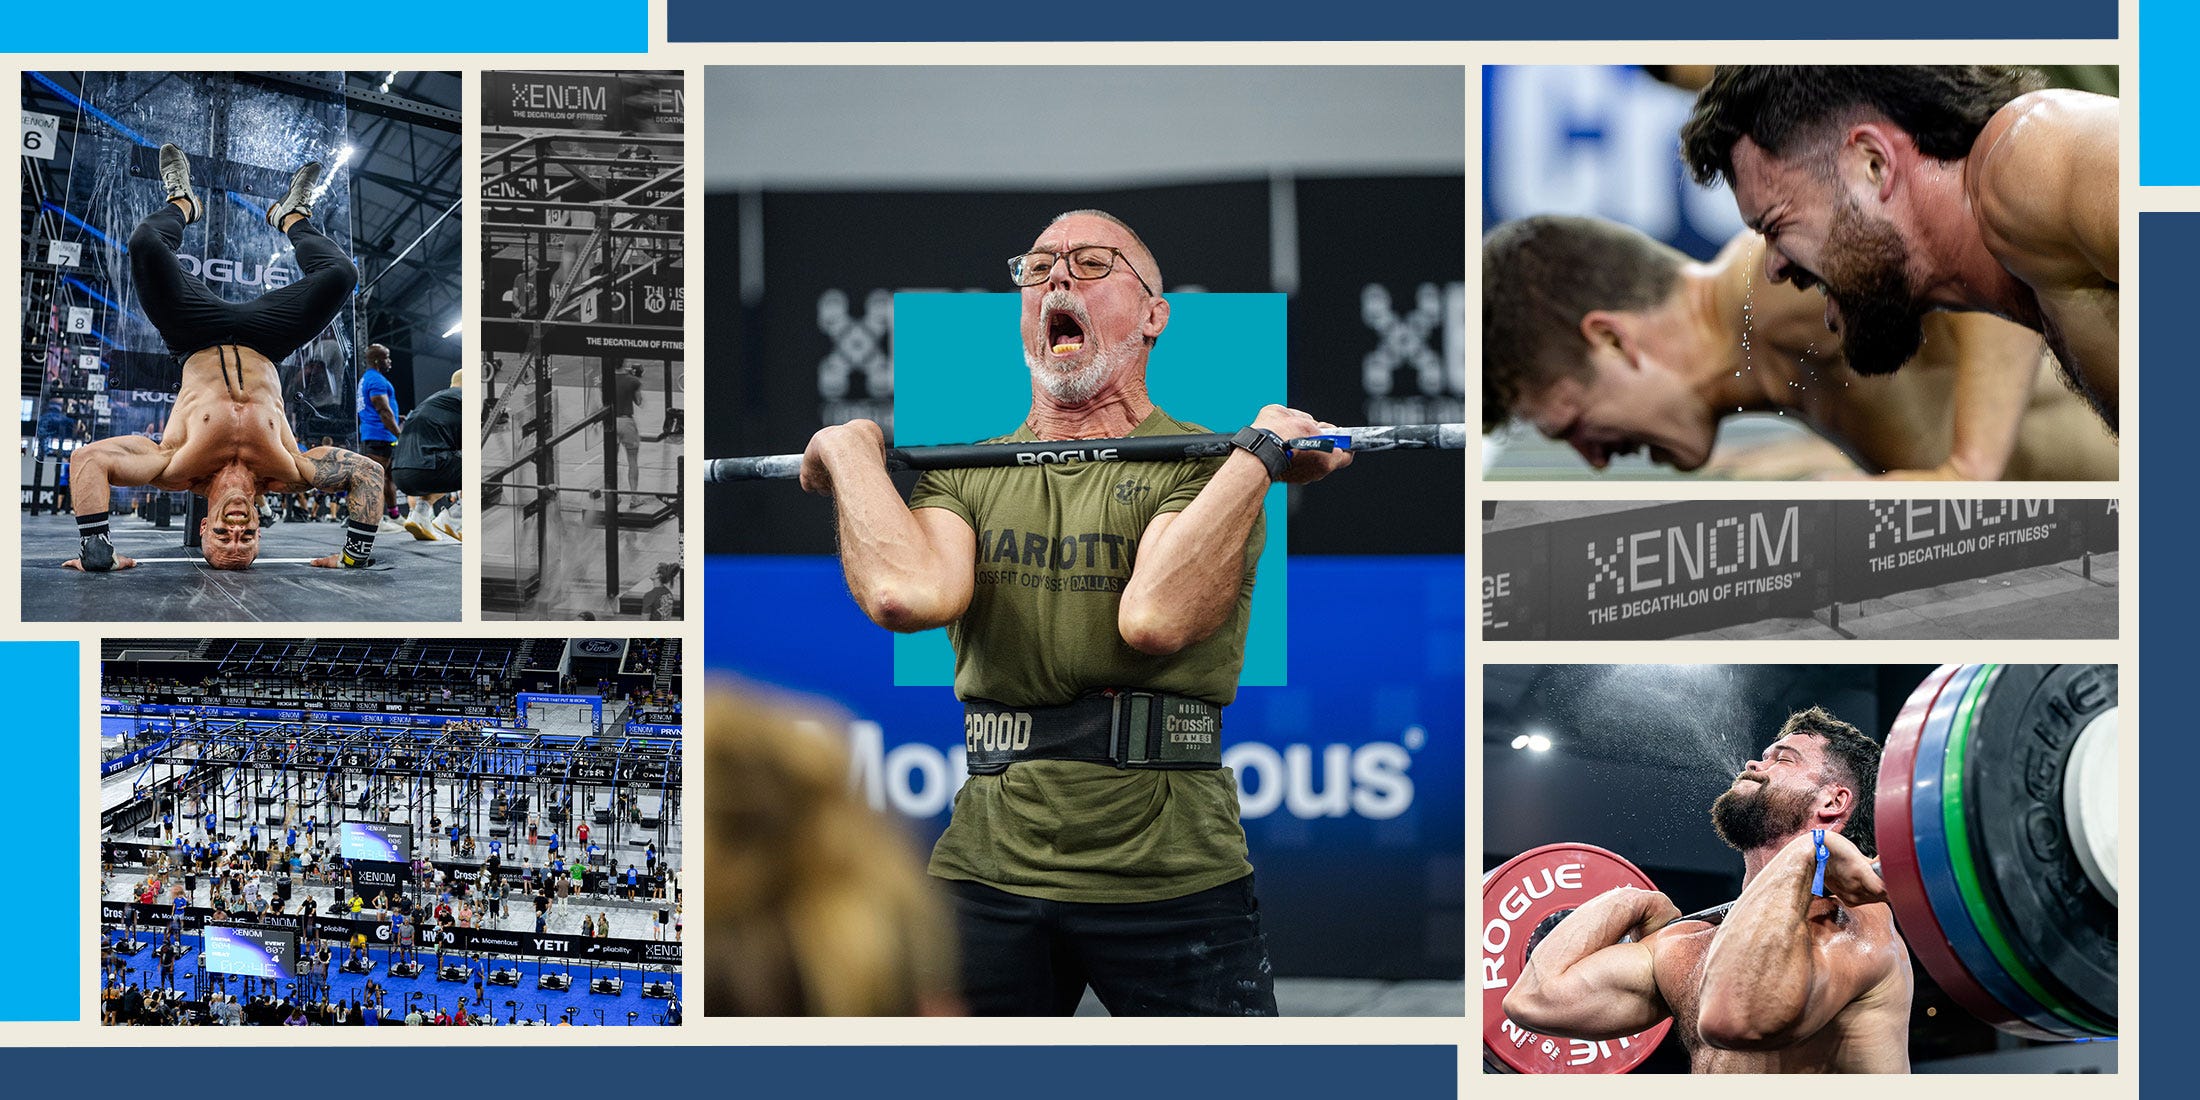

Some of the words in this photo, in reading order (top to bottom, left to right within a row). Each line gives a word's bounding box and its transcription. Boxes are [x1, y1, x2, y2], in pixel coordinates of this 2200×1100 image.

[511, 83, 607, 111] XENOM
[512, 110, 526, 118] THE
[527, 111, 566, 120] DECATHLON
[566, 112, 576, 120] OF
[23, 131, 42, 150] 6
[59, 254, 70, 266] 7
[175, 253, 290, 289] OGUE
[585, 298, 592, 316] 4
[75, 318, 85, 329] 8
[586, 336, 602, 346] THE
[603, 337, 649, 347] DECATHLON
[650, 340, 661, 348] OF
[85, 357, 93, 366] 9
[1016, 449, 1119, 467] ROGUE
[1587, 505, 1799, 601] XENOM
[1868, 554, 1896, 573] THE
[1898, 538, 1976, 568] DECATHLON
[1978, 534, 1996, 551] OF
[1021, 572, 1072, 592] ODYSSEY
[1071, 576, 1119, 592] DALLAS
[1588, 601, 1618, 626] THE
[1621, 588, 1710, 620] DECATHLON
[1712, 583, 1732, 601] OF
[586, 641, 612, 653] Ford
[1178, 703, 1208, 715] NOBULL
[628, 725, 654, 733] XENOM
[1166, 714, 1215, 733] CrossFit
[964, 713, 1033, 752] 2POOD
[1174, 734, 1211, 743] GAMES
[108, 760, 124, 773] YETI
[139, 848, 164, 859] YET
[359, 871, 396, 883] XENOM
[1483, 863, 1584, 990] ROGUE
[232, 928, 263, 938] XENOM
[482, 937, 519, 947] Momentous
[533, 938, 570, 952] YETI
[265, 945, 285, 955] 007
[271, 955, 280, 963] 4
[1549, 1046, 1561, 1061] IWF
